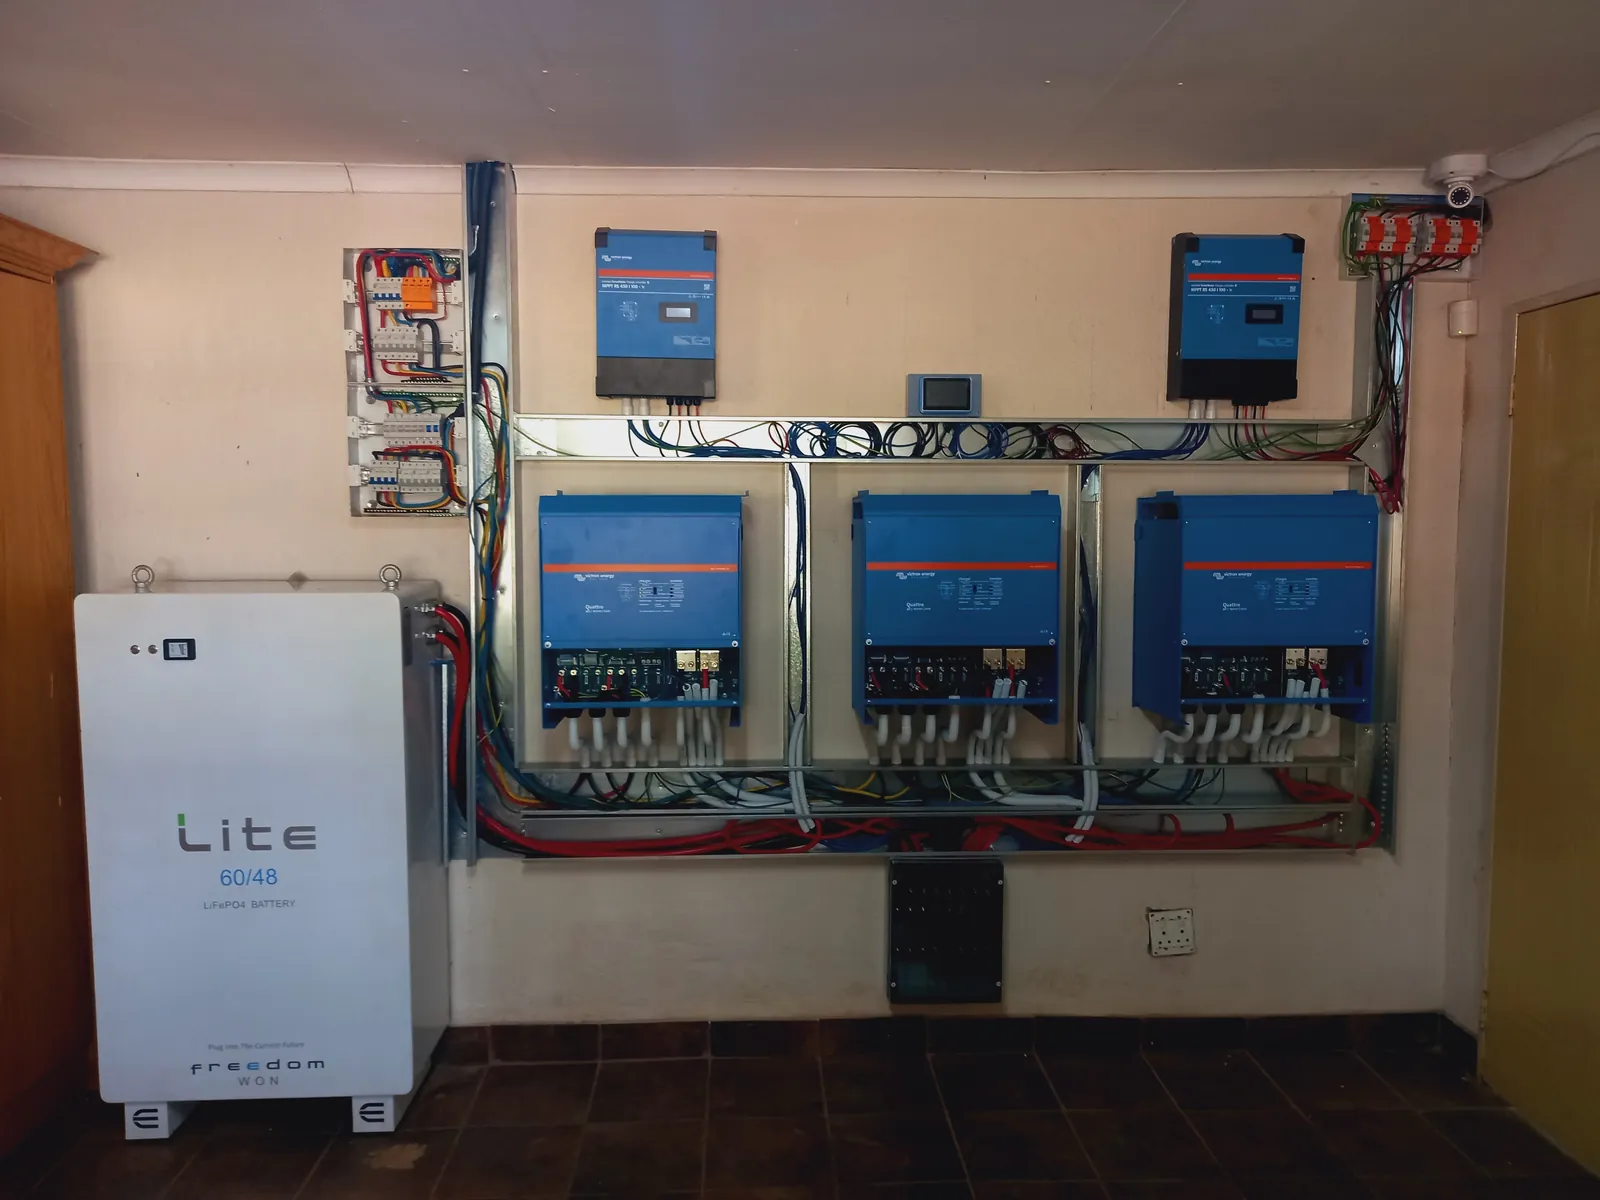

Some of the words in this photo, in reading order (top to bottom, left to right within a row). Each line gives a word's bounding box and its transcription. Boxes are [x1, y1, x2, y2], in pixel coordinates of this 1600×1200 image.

[177, 813, 317, 852] Lite
[219, 868, 278, 886] 60/48
[203, 901, 246, 910] LiFePO4
[251, 899, 296, 909] BATTERY
[190, 1058, 325, 1075] freedom
[239, 1076, 279, 1086] WON
